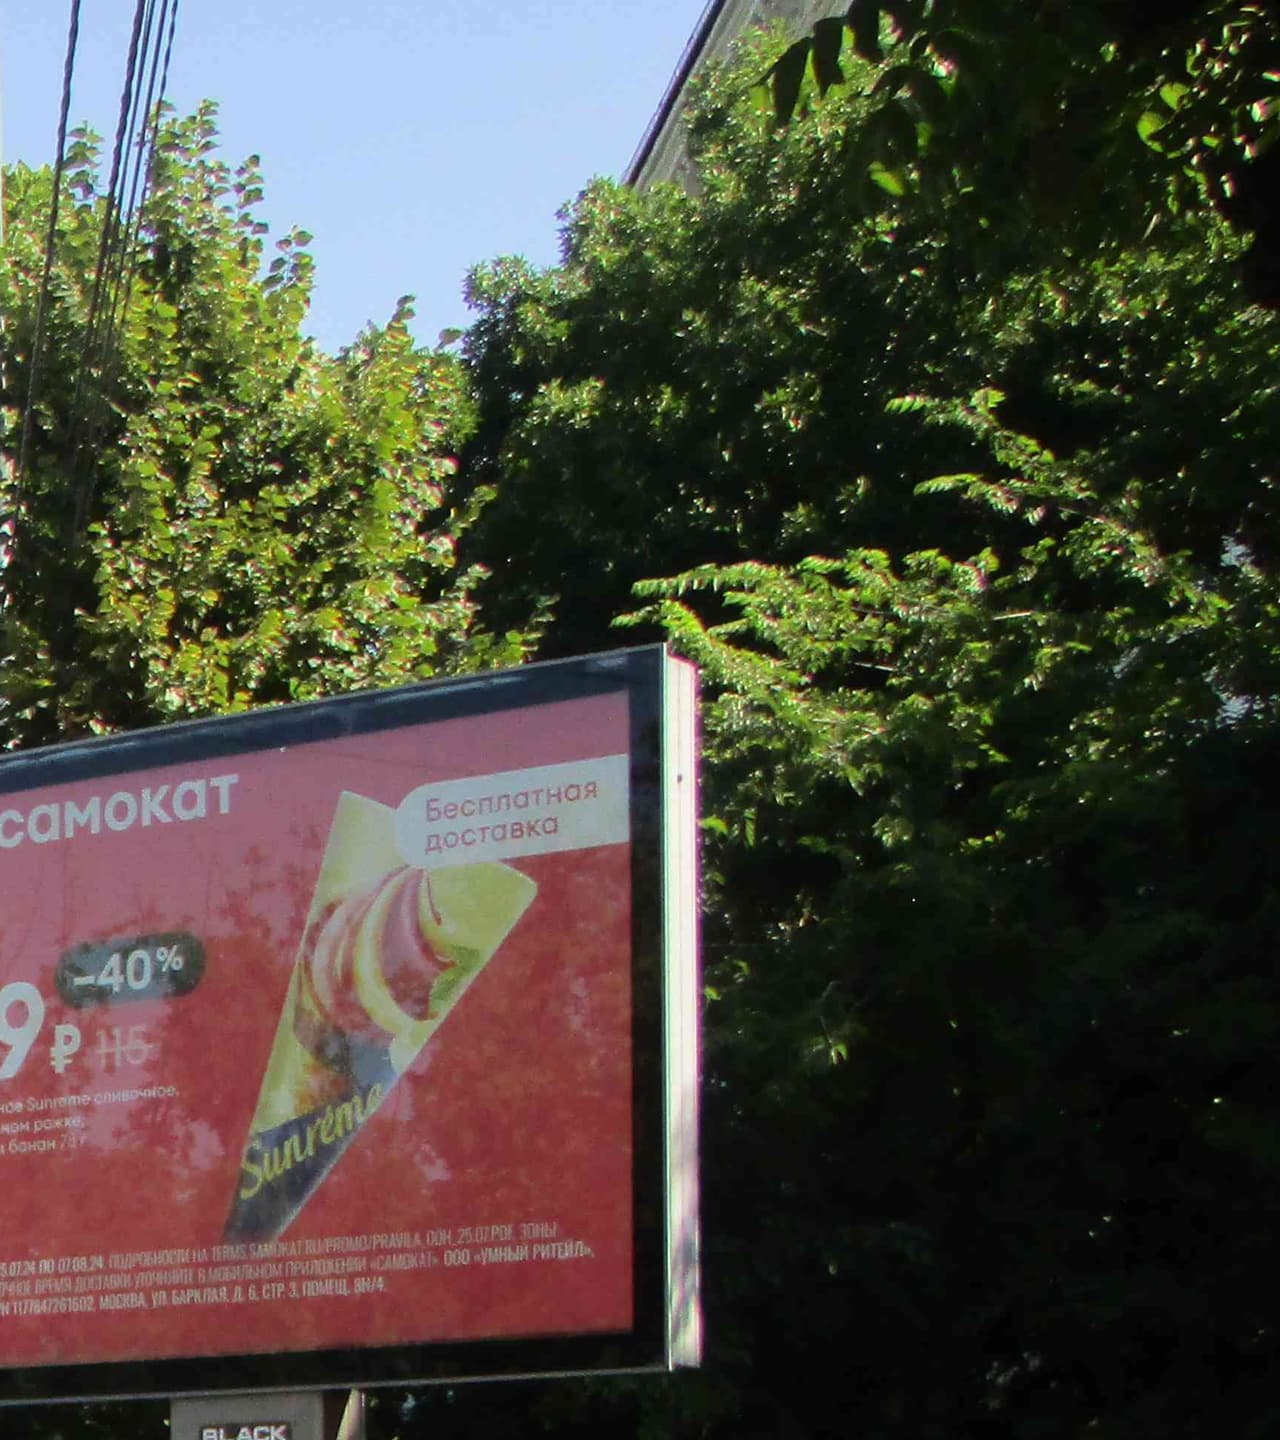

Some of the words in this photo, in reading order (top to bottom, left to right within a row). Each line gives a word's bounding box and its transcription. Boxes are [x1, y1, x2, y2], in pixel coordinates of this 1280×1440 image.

[425, 781, 598, 822] Бесплатная
[425, 817, 559, 855] доставка
[27, 1093, 91, 1113] Sunreme
[33, 1115, 85, 1132] рожке,
[8, 1138, 56, 1155] банан
[39, 1258, 55, 1274] ПО
[109, 1248, 188, 1269] ПОДРОБНОСТИ
[191, 1247, 208, 1264] НА
[519, 1221, 559, 1240] ЗОНЫ
[34, 1277, 72, 1294] ВРЕМЯ
[75, 1274, 131, 1292] ДОСТАВКИ
[198, 1268, 205, 1284] В
[207, 1263, 284, 1283] МОБИЛЬНОМ
[285, 1258, 367, 1279] ПРИЛОЖЕНИИ
[443, 1249, 470, 1267] ООО
[474, 1244, 529, 1266] «УМНЫЙ
